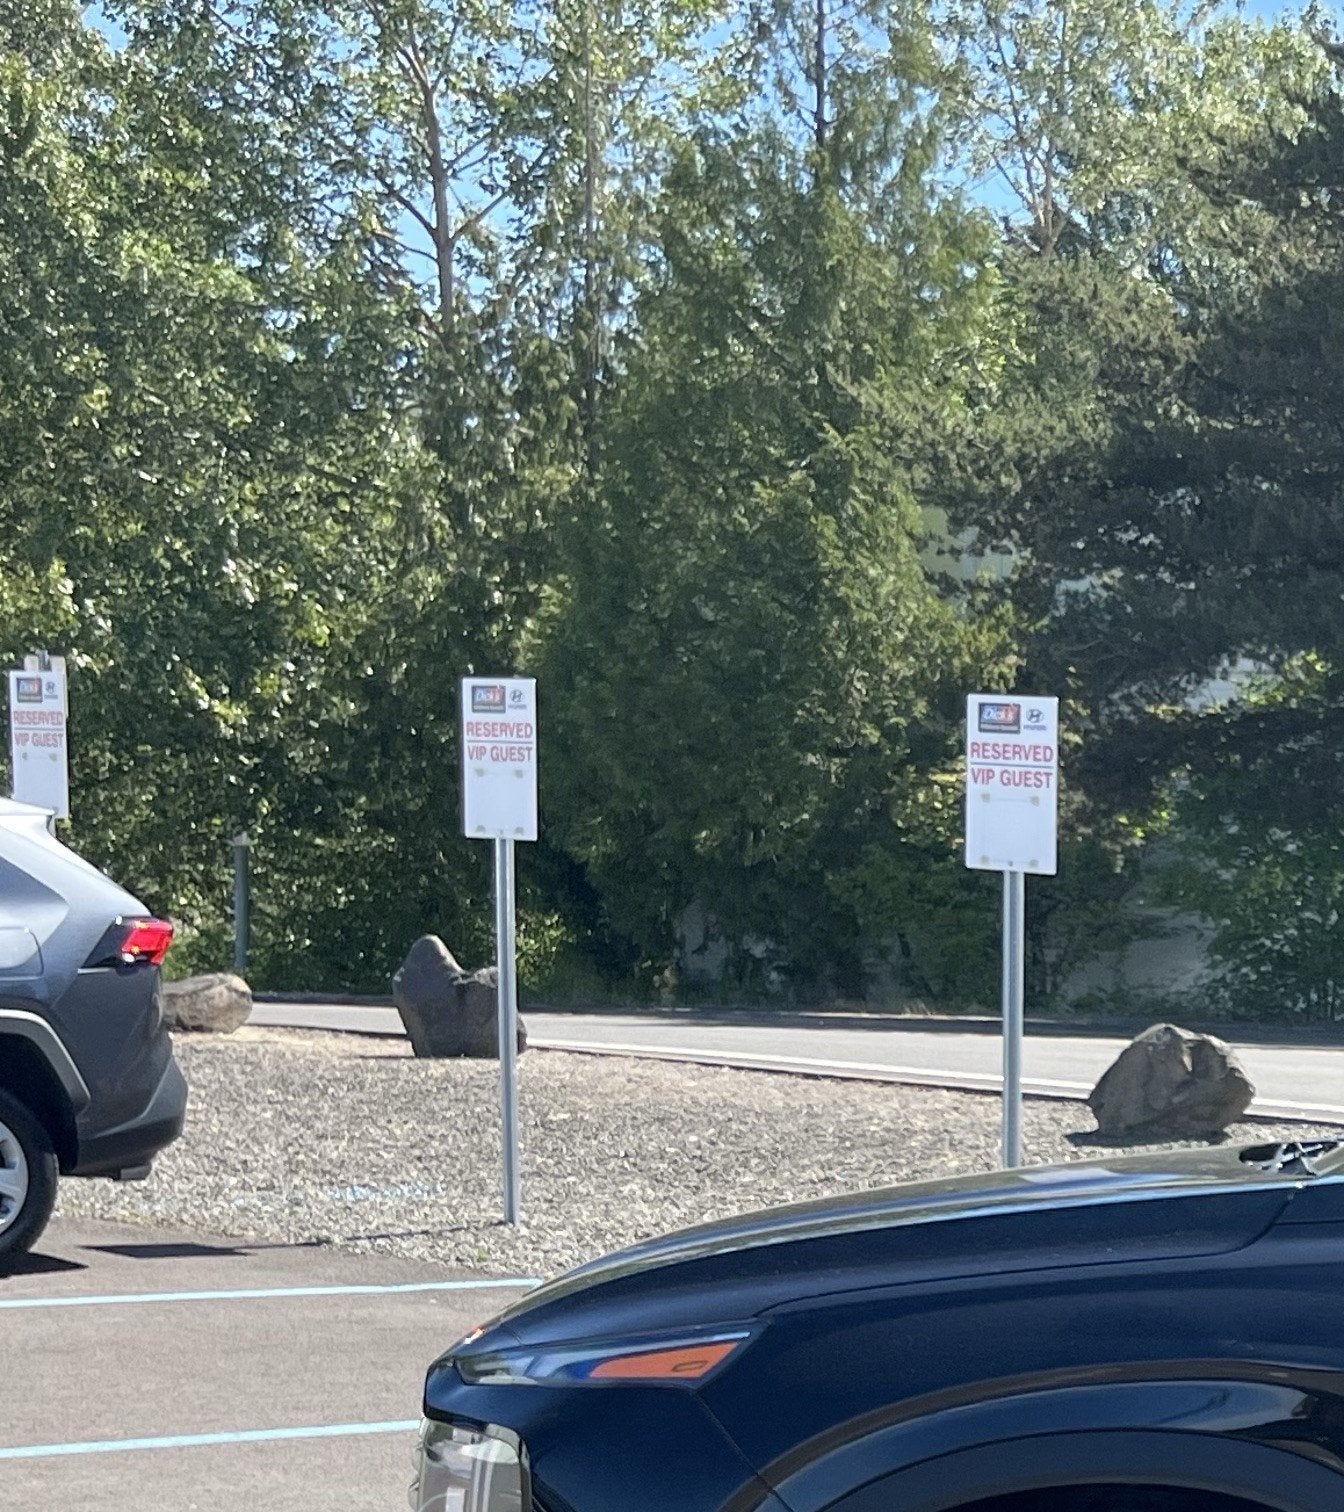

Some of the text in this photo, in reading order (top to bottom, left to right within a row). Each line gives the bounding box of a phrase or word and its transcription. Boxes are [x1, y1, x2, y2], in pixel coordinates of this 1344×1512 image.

[13, 711, 63, 725] RESERVED
[467, 722, 533, 738] RESERVED
[15, 733, 63, 748] VIP GUEST
[468, 745, 532, 761] VIP GUEST
[971, 742, 1054, 763] RESERVED
[971, 767, 1053, 788] VIP GUEST
